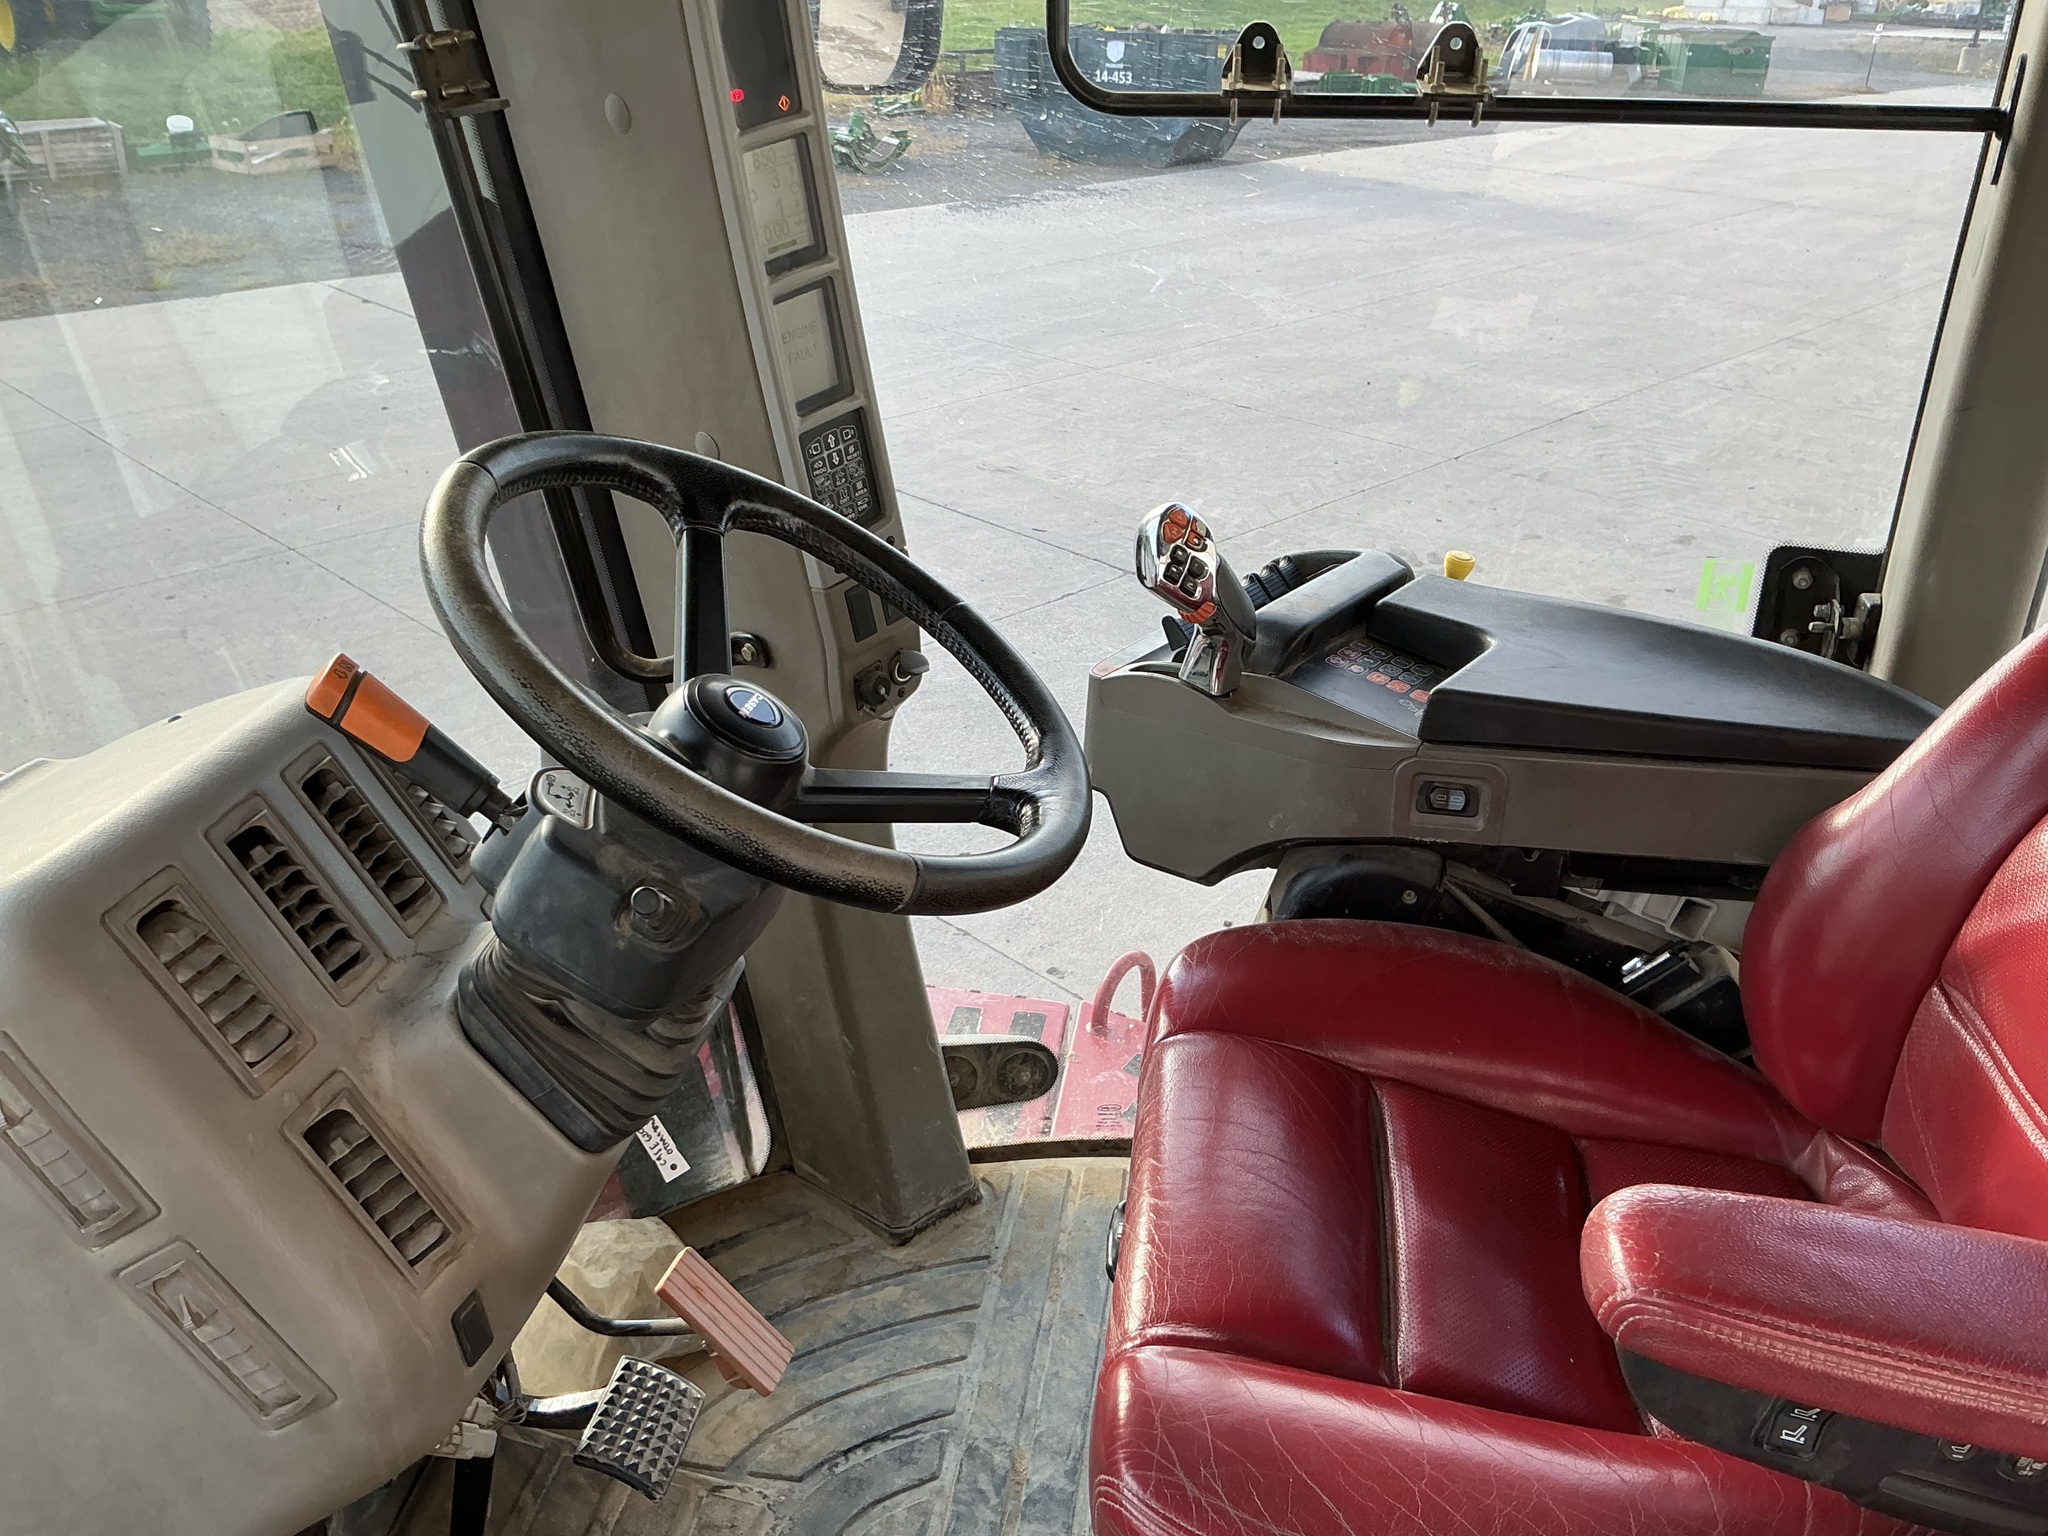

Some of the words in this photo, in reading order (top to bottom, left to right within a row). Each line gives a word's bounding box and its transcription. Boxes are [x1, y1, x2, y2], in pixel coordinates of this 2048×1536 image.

[1095, 69, 1132, 84] 14-453
[752, 147, 776, 170] 850
[781, 320, 817, 344] ENGINE
[788, 342, 818, 365] FAULT
[846, 450, 860, 460] RESET
[813, 466, 826, 476] PROG
[855, 488, 867, 497] AREA
